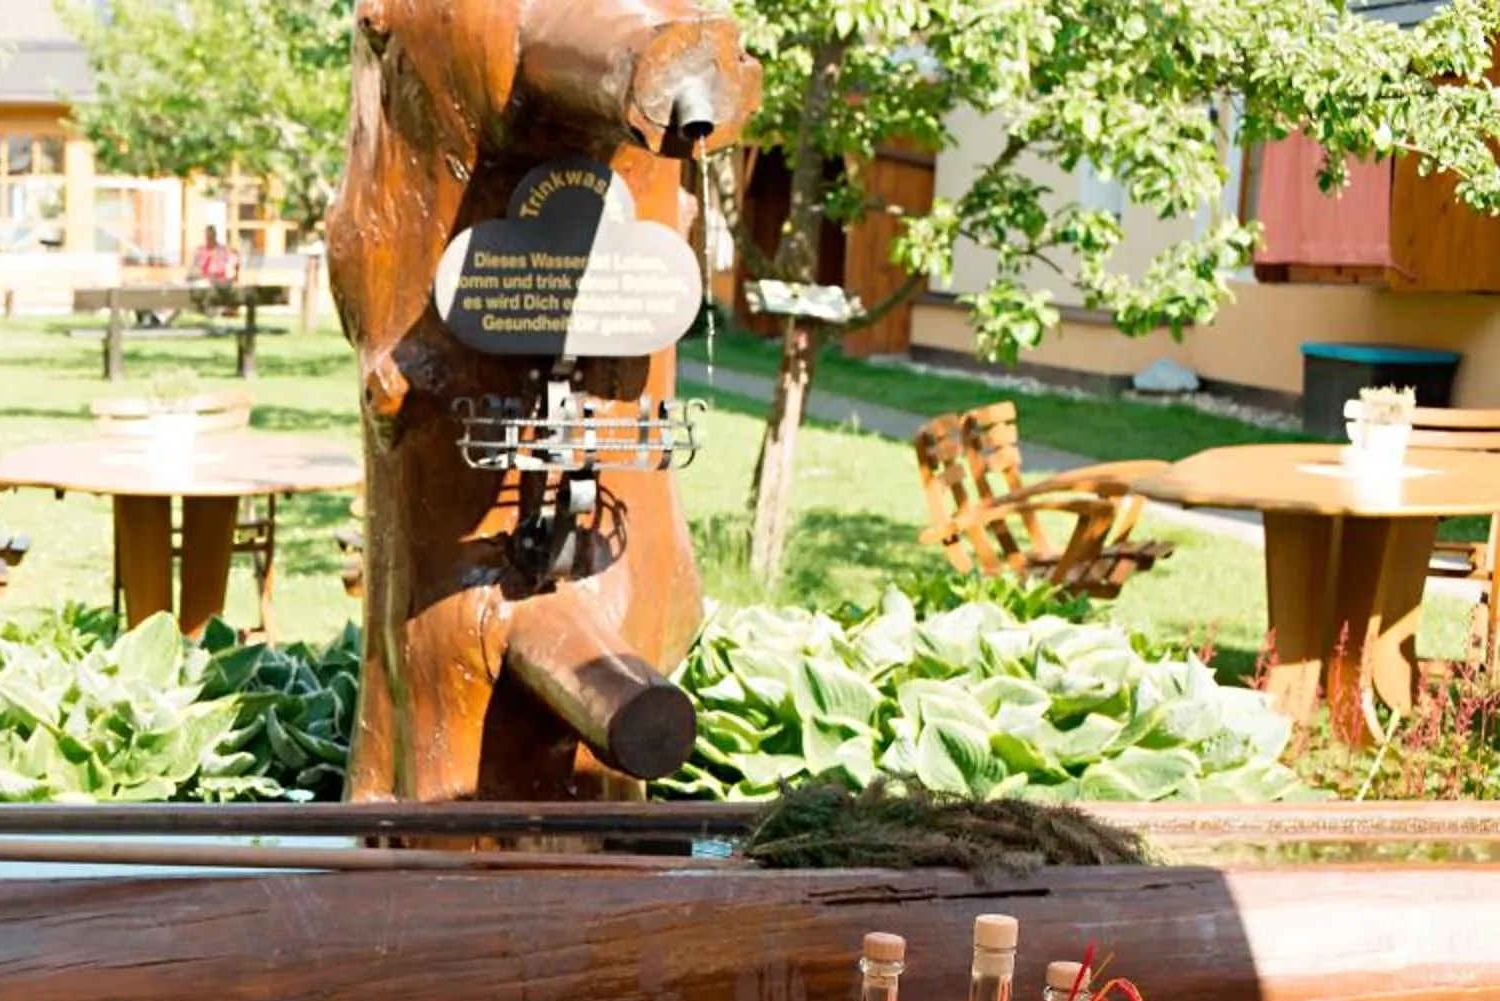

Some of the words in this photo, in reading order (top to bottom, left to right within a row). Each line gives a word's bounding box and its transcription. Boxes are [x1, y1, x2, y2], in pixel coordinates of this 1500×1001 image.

[519, 169, 624, 222] Trinkwas
[473, 251, 528, 269] Dieses
[530, 250, 587, 269] Wasser
[453, 275, 499, 289] omm
[502, 272, 533, 290] und
[536, 272, 572, 290] trink
[463, 295, 483, 312] es
[485, 292, 520, 312] wird
[523, 292, 560, 312] Dich
[481, 312, 572, 333] Gesundheit
